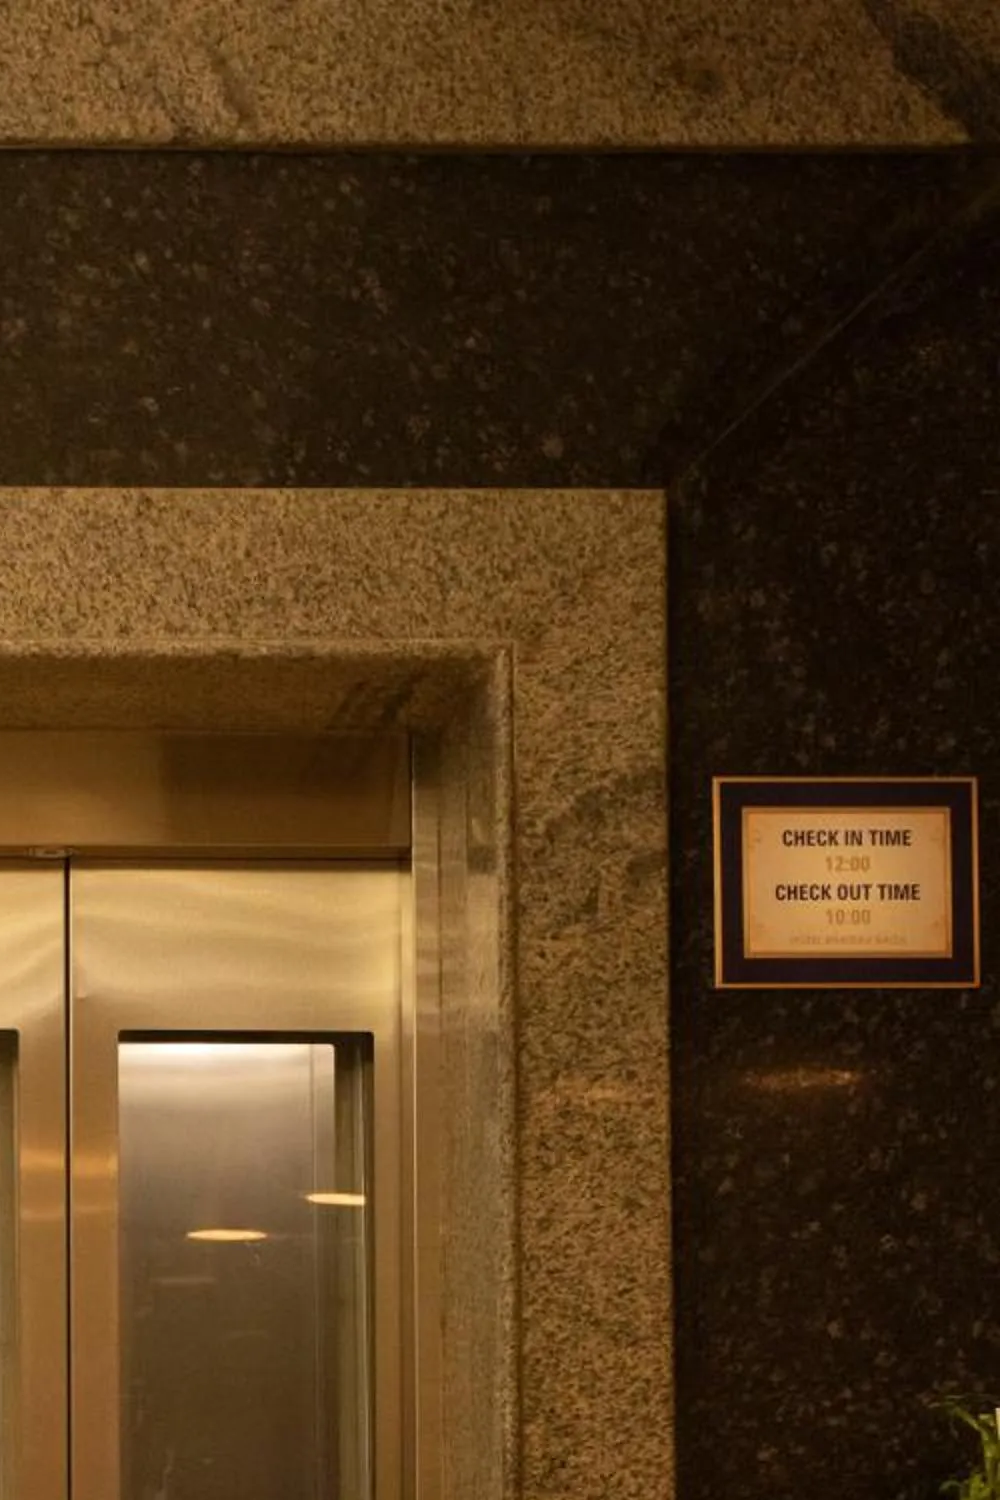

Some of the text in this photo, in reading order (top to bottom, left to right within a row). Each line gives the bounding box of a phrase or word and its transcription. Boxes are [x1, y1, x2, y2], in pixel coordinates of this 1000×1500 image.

[782, 829, 912, 846] CHECK IN TIME
[825, 856, 871, 872] 12:00
[775, 884, 921, 901] CHECK OUT TIME
